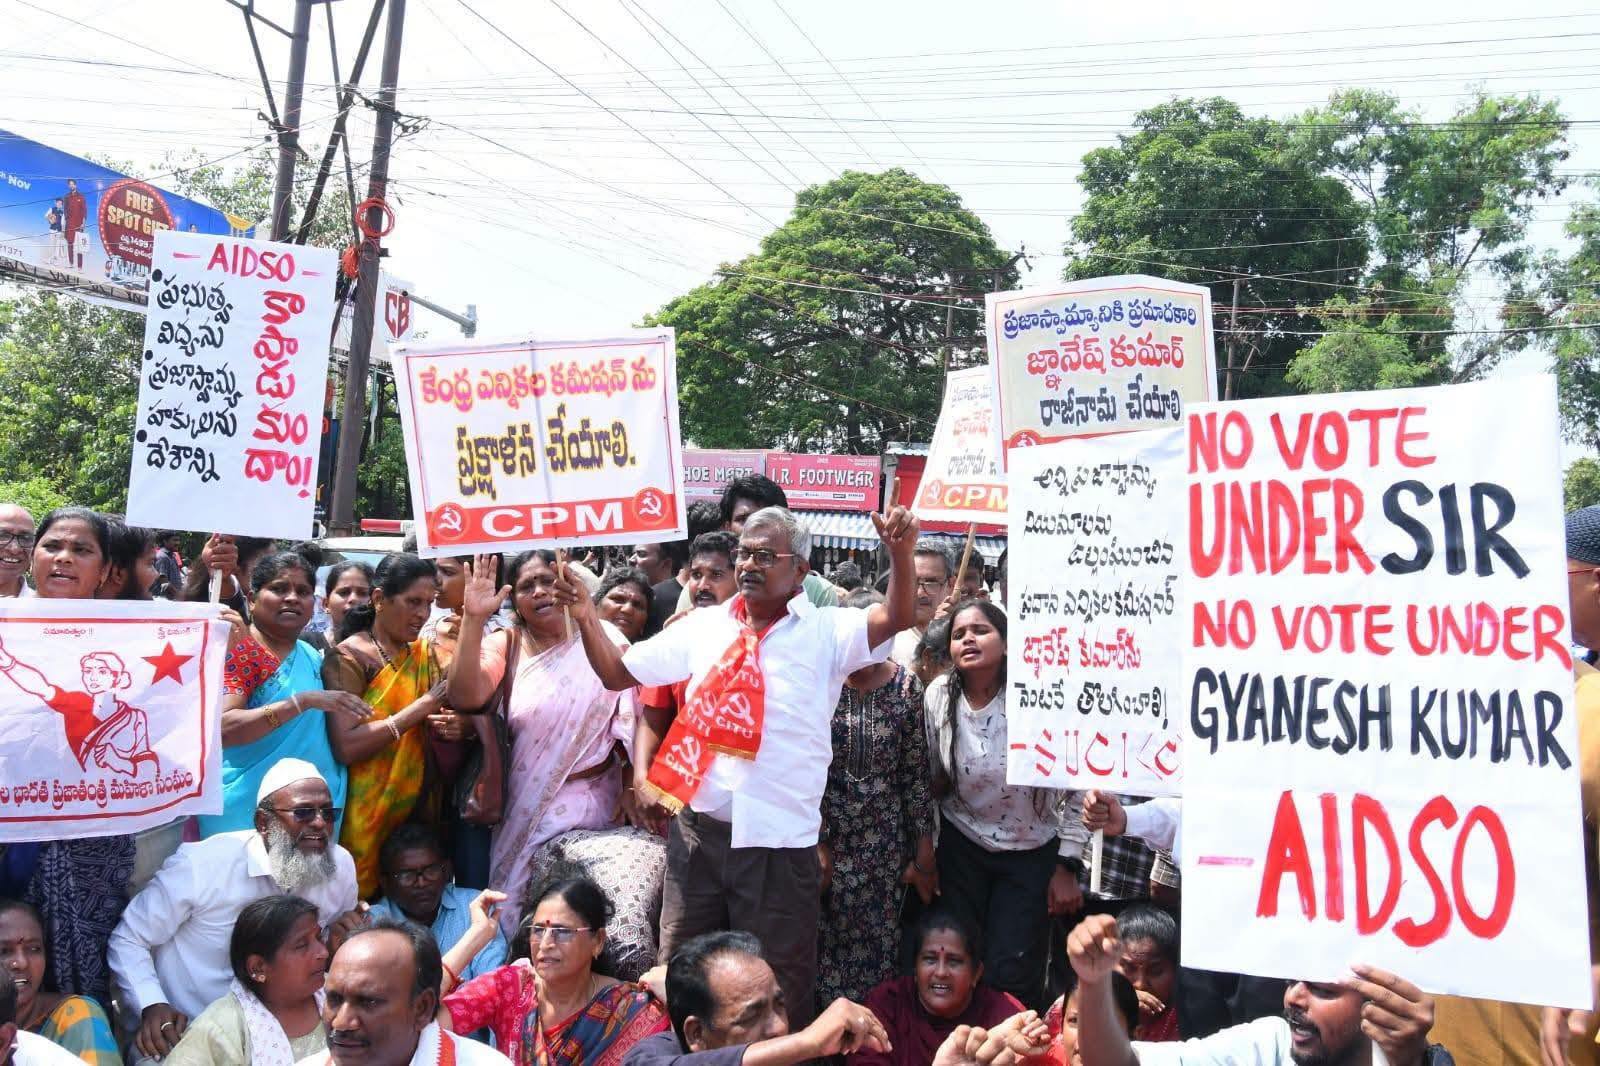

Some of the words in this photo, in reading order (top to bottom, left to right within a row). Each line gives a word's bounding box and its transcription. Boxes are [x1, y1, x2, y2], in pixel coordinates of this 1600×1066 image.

[8, 174, 31, 190] Nov
[126, 190, 153, 214] FREE
[107, 205, 141, 231] SPOT
[157, 275, 233, 324] ప్రభుత్వ
[1004, 300, 1124, 339] ప్రజాస్వామ్యానికి
[1128, 299, 1196, 328] ప్రమాదకారి
[158, 318, 224, 357] విద్యను
[1110, 332, 1184, 368] కుమార్
[149, 357, 243, 408] ప్రజాస్వామ్య
[418, 365, 473, 413] కేంద్ర
[476, 364, 546, 410] ఎన్నికల
[1125, 373, 1181, 423] చేయాలి
[147, 399, 237, 439] హక్కులను
[147, 437, 220, 482] దేశాన్ని
[1187, 410, 1254, 474] NO
[1271, 407, 1437, 472] VOTE
[683, 466, 710, 482] HOE
[714, 466, 753, 481] MART
[799, 468, 874, 488] FOOTWEAR
[481, 502, 624, 538] CPM
[1188, 478, 1376, 578] UNDER
[1380, 479, 1531, 580] SIR
[1193, 599, 1256, 650] NO
[1272, 604, 1394, 655] VOTE
[1407, 601, 1573, 671] UNDER
[716, 716, 754, 738] CITU
[1190, 667, 1393, 755] GYANESH
[1410, 685, 1572, 770] KUMAR
[13, 780, 48, 807] భారత
[51, 779, 107, 810] ప్రజాతంత్ర
[110, 778, 153, 800] మహిళా
[155, 769, 193, 795] సంఘం
